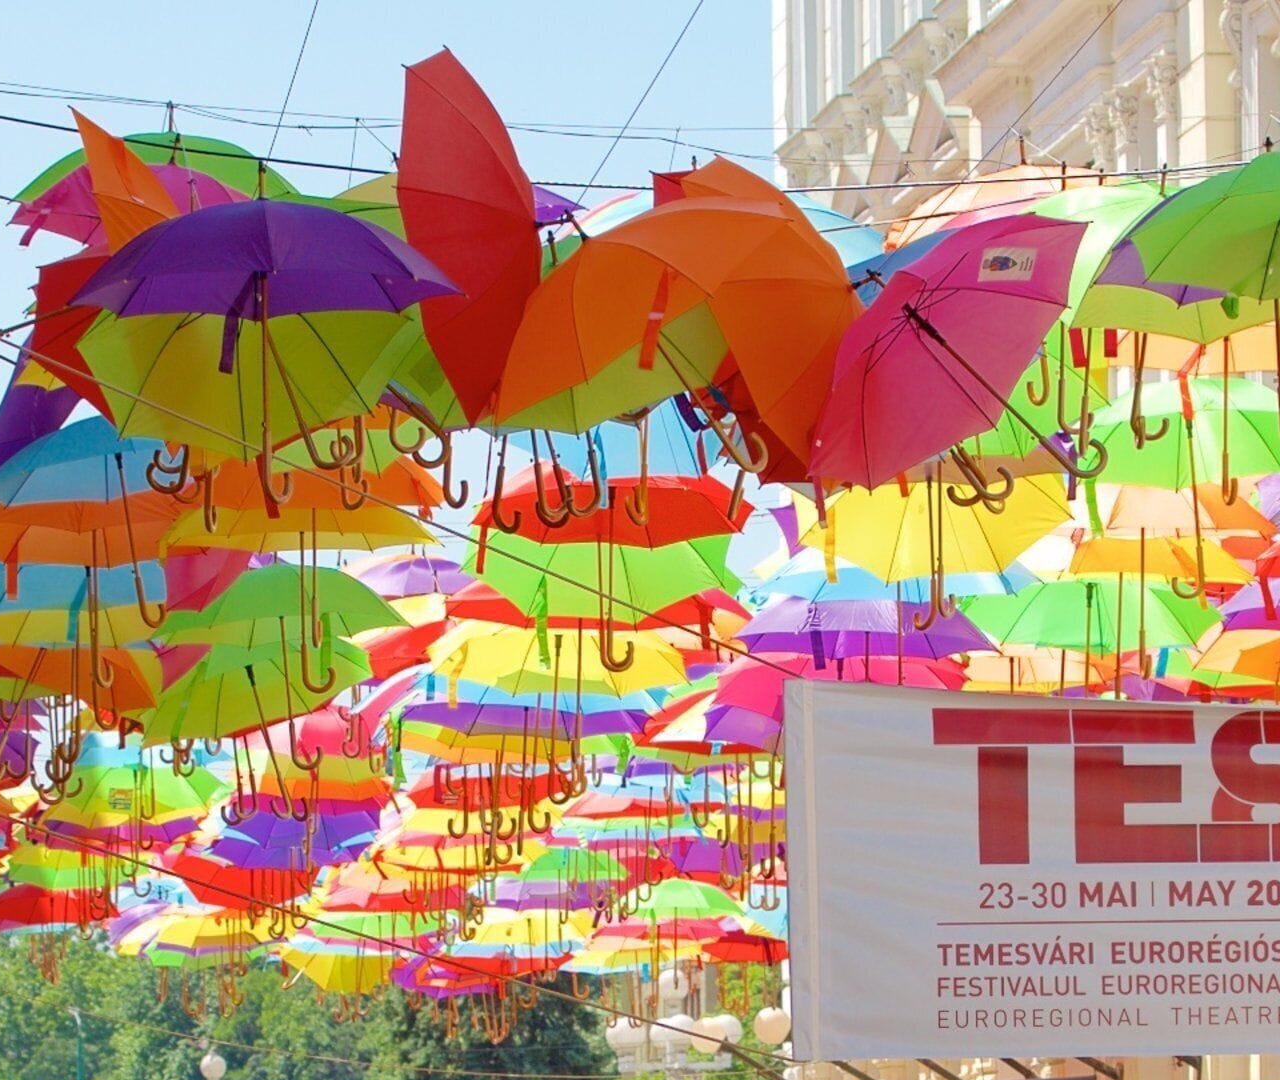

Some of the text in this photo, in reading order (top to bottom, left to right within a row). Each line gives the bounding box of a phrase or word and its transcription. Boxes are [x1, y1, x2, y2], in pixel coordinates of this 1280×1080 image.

[979, 882, 1067, 909] 23-30
[1079, 881, 1137, 908] MAI
[1169, 880, 1235, 908] MAY
[936, 935, 1094, 966] TEMESVÁRI
[937, 975, 1087, 998] FESTIVALUL
[937, 1008, 1149, 1029] EUROREGIONAL
